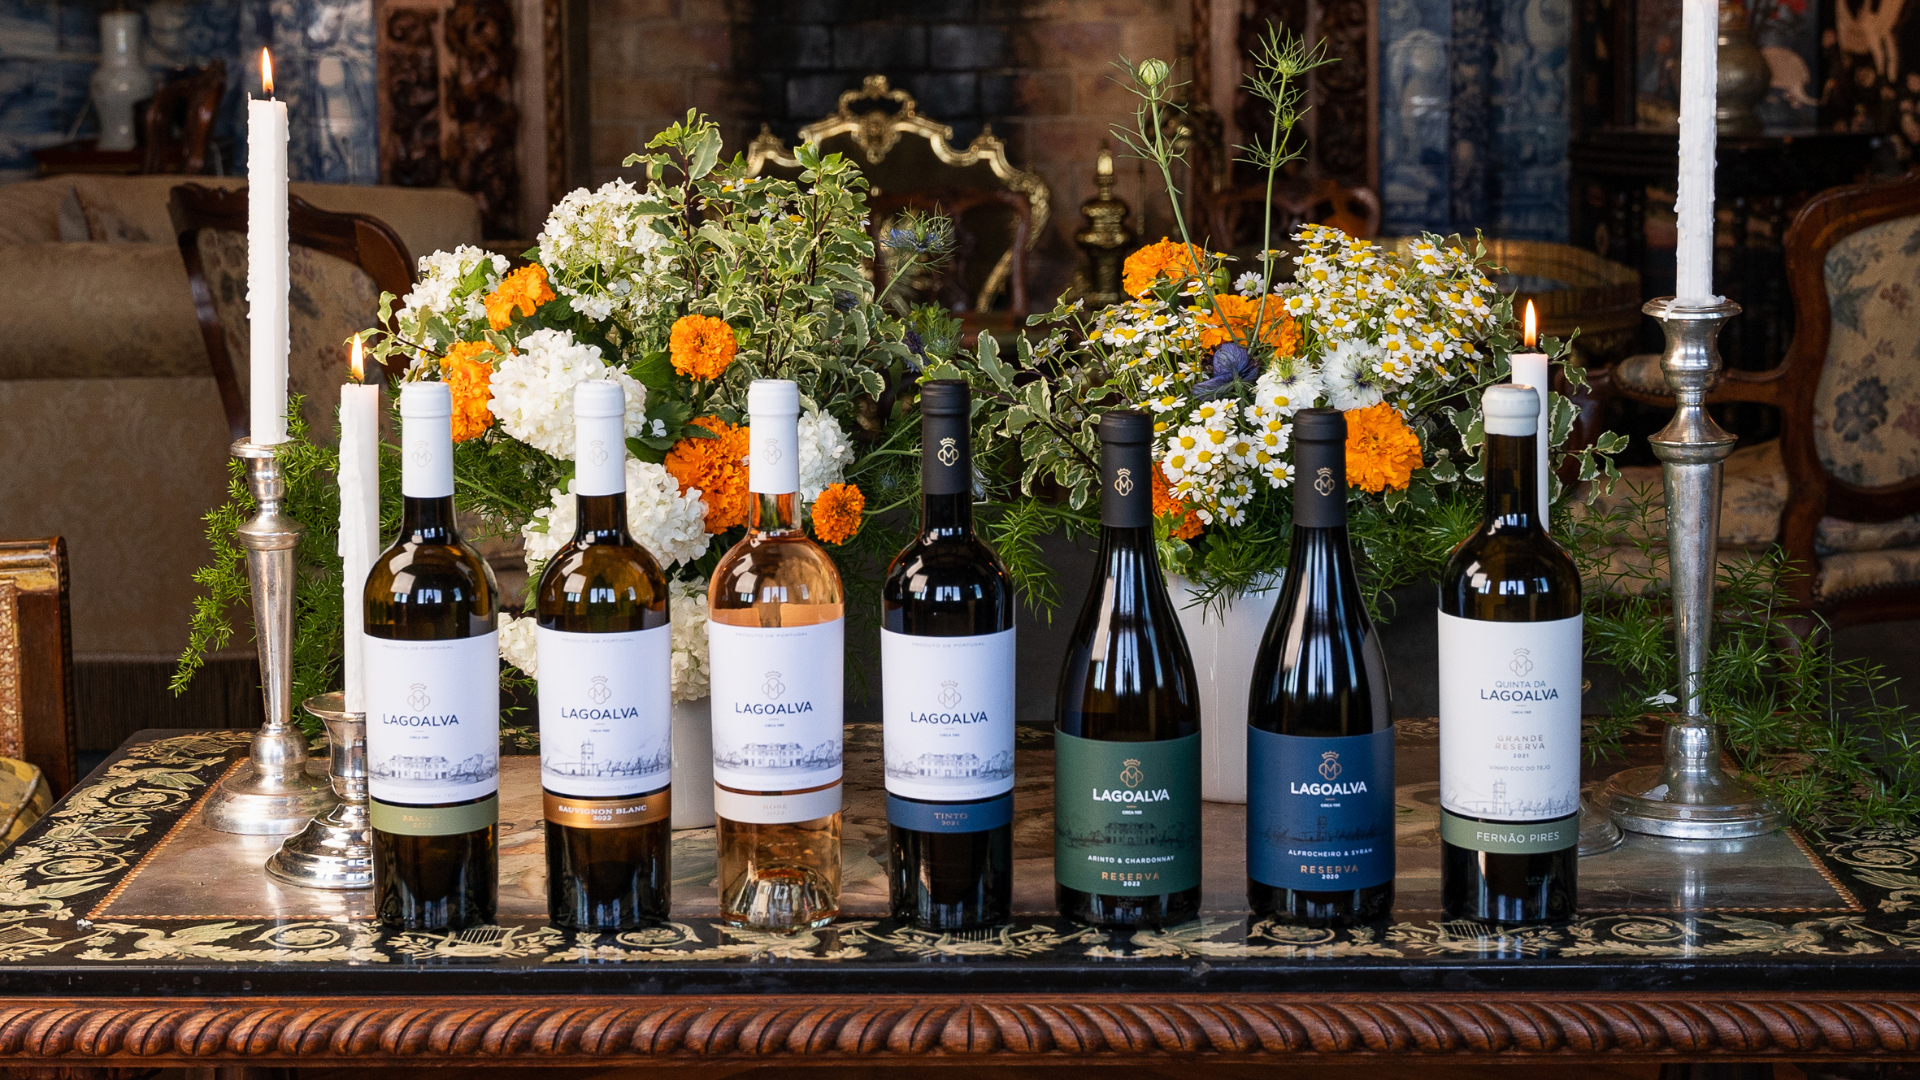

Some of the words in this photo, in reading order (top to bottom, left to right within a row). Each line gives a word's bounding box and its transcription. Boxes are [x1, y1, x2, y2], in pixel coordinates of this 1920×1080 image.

[1495, 680, 1531, 689] QUINTA
[1533, 680, 1547, 688] DA
[1480, 688, 1559, 702] LAGOALVA
[561, 706, 639, 720] LAGOALVA
[735, 701, 813, 715] LAGOALVA
[383, 713, 460, 727] LAGOALVA
[910, 711, 988, 725] LAGOALVA
[1497, 734, 1544, 742] GRANDE
[1494, 742, 1545, 751] RESERVA
[1290, 780, 1368, 796] LAGOALVA
[1092, 787, 1170, 803] LAGOALVA
[558, 805, 612, 815] SAUVIGNON
[615, 804, 647, 815] BLANC
[933, 812, 968, 820] TINTO
[1476, 831, 1526, 844] FERNÃO
[1529, 831, 1560, 843] PIRES
[1288, 849, 1342, 858] ALFROCHEIRO
[1351, 847, 1373, 856] SYRAH
[1087, 854, 1115, 864] ARINTO
[1125, 855, 1175, 864] CHARDONNAY
[1300, 864, 1359, 875] RESERVA
[1101, 871, 1160, 882] RESERVA
